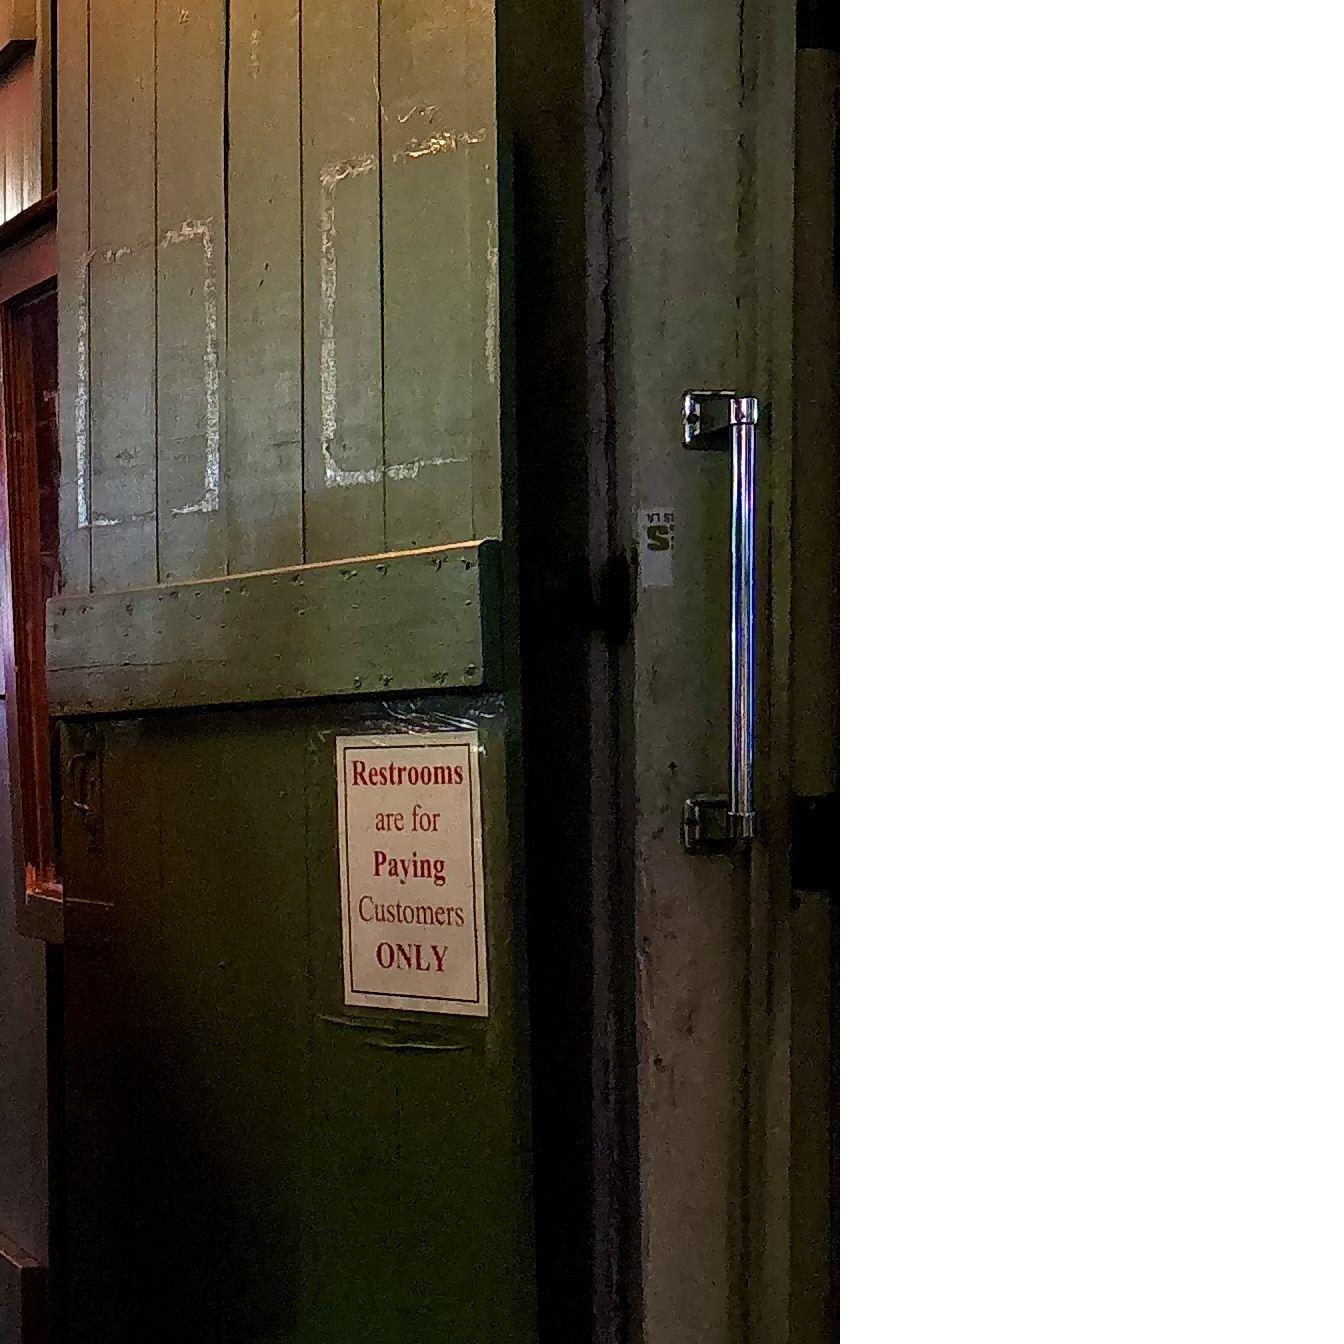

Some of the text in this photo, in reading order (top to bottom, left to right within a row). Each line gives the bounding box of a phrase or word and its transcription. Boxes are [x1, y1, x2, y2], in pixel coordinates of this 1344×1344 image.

[351, 759, 464, 787] Restrooms
[375, 804, 441, 833] are for
[372, 850, 447, 887] Paying
[358, 894, 465, 928] Customers
[375, 941, 449, 973] ONLY
